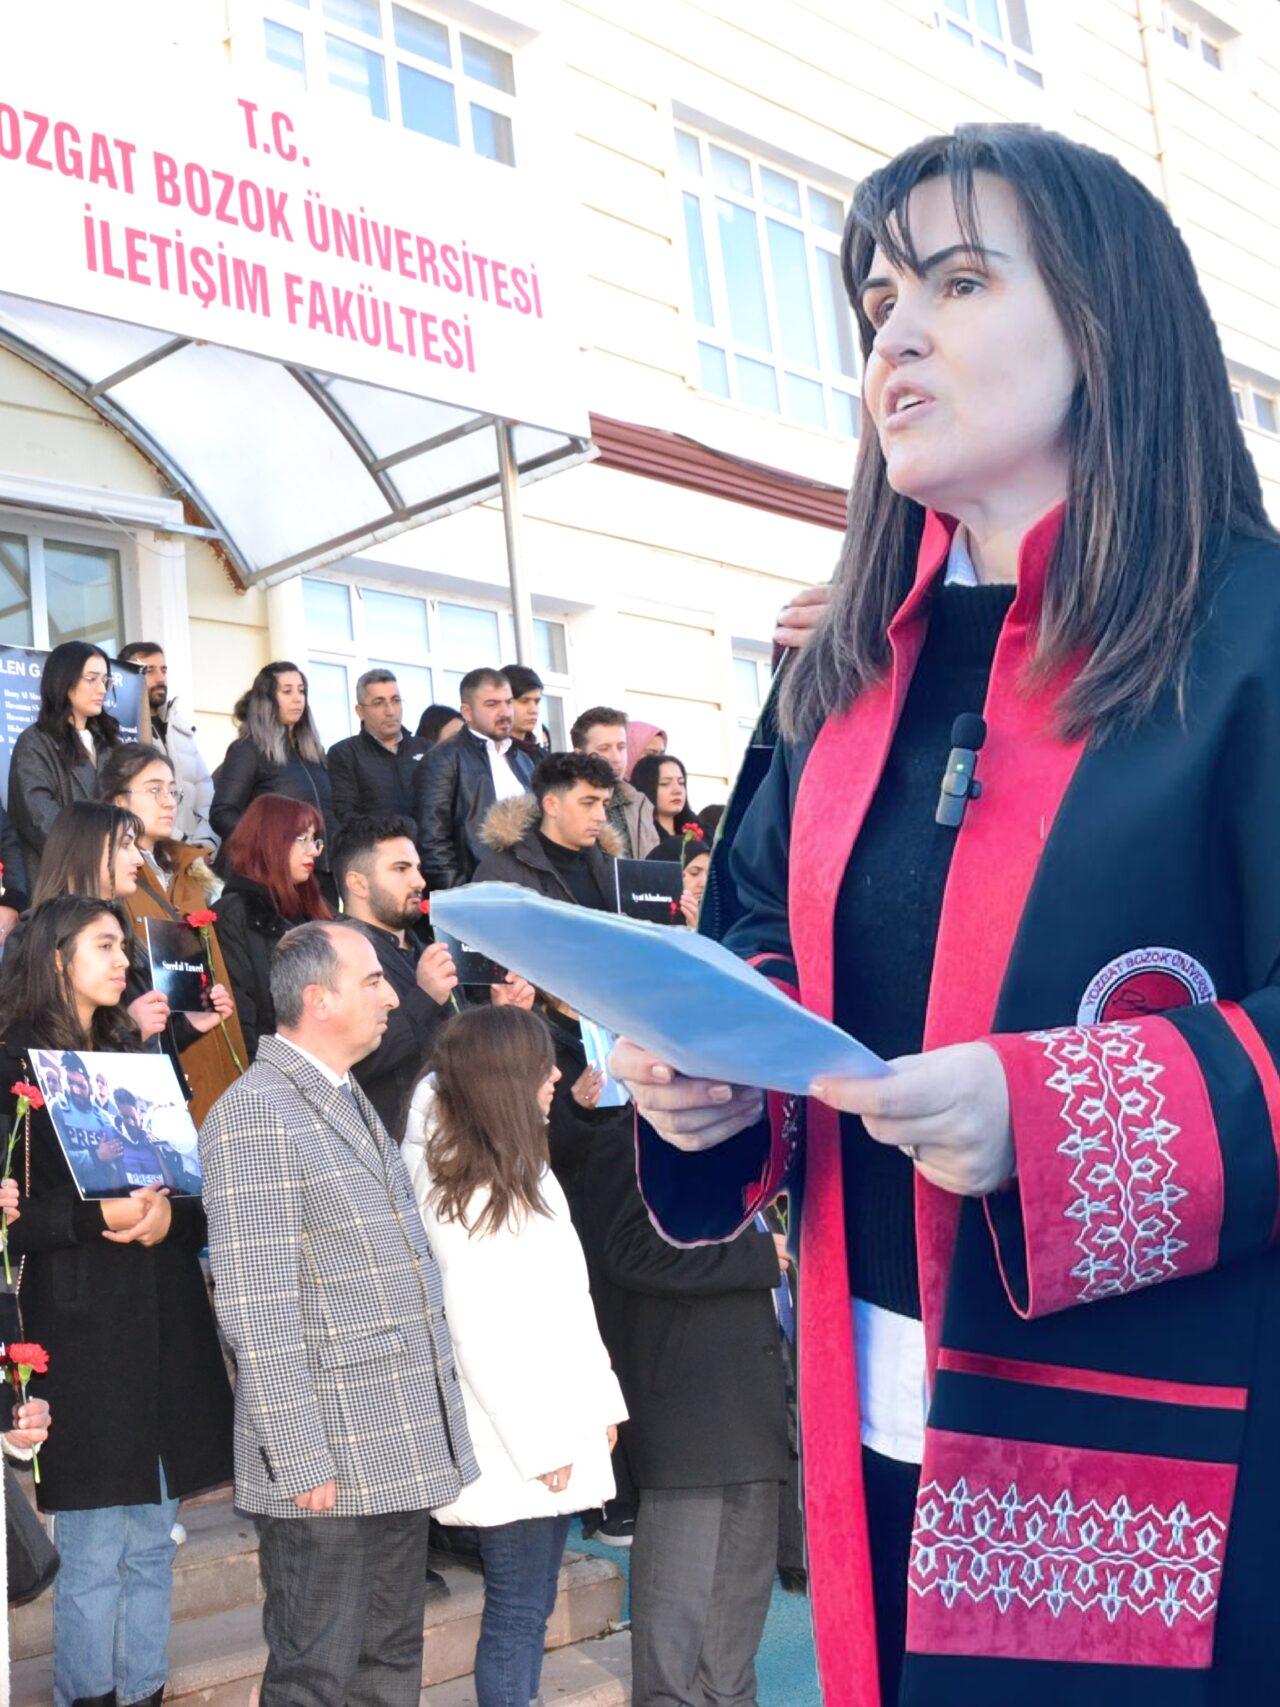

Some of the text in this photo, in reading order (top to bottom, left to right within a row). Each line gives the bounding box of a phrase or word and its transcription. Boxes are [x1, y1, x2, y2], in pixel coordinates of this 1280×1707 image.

[237, 97, 311, 167] T.C.
[83, 202, 476, 373] İLETİŞİM FAKÜLTESİ
[153, 150, 294, 242] BOZOK
[303, 189, 543, 319] ÜNİVERSİTESİ
[1085, 963, 1124, 1005] YOZGAT
[1125, 952, 1171, 968] BOZOK
